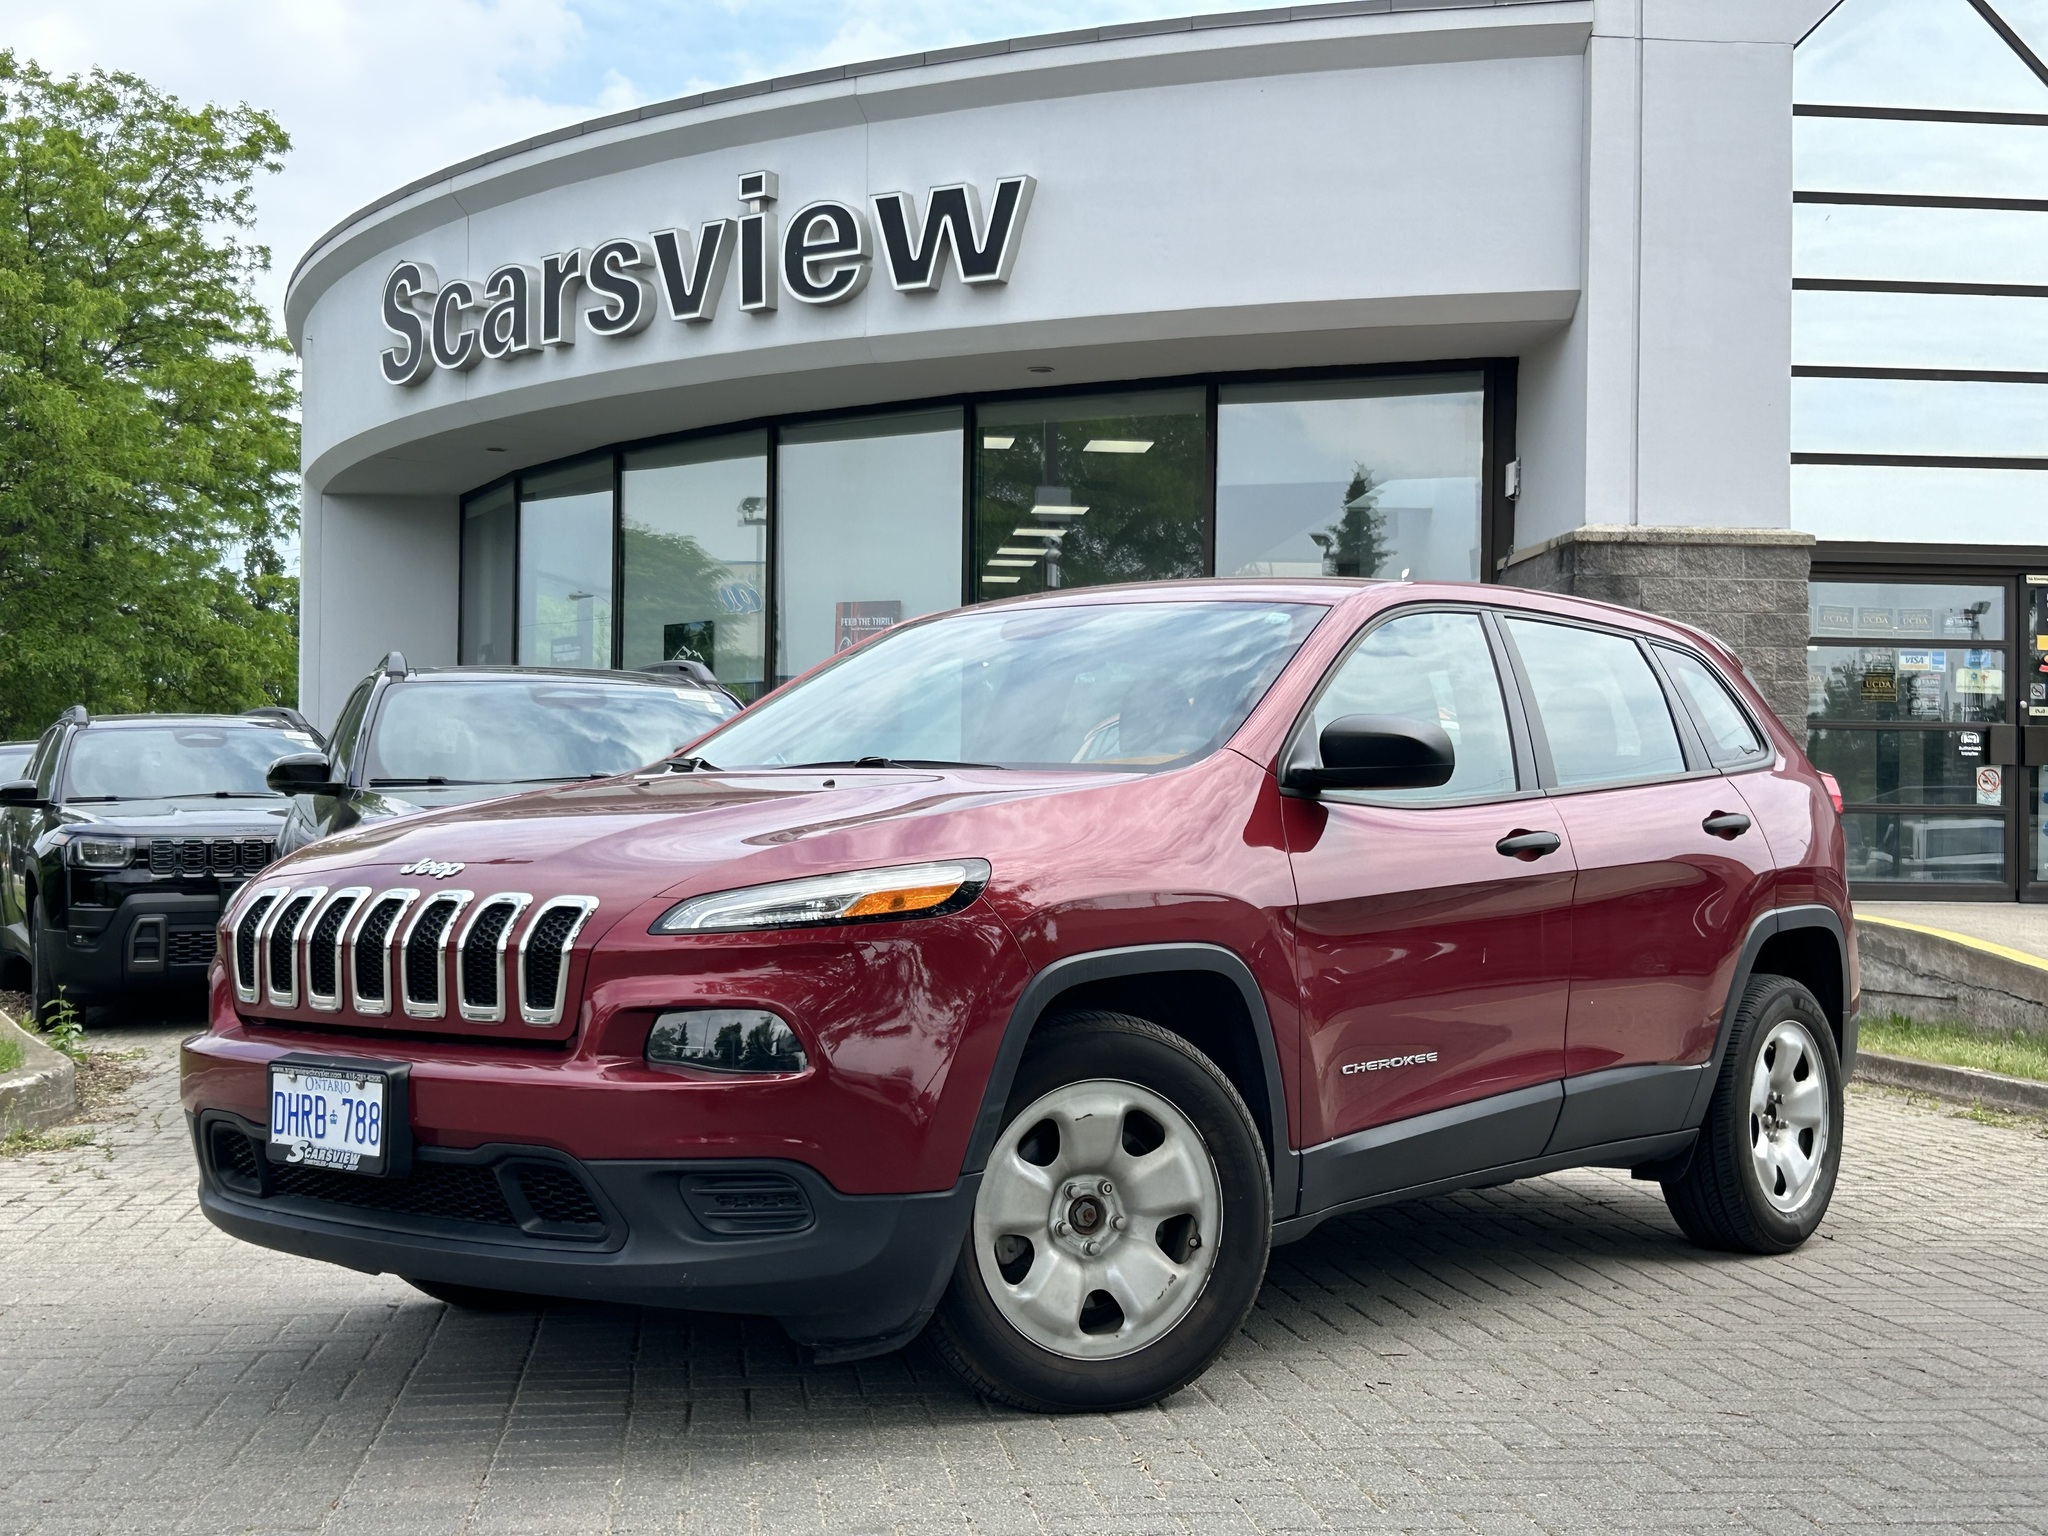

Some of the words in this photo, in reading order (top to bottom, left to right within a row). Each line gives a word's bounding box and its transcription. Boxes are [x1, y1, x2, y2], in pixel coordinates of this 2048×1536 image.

[379, 170, 1036, 386] Scarsview
[858, 617, 871, 626] THE
[872, 616, 894, 626] THRILL
[1823, 614, 1849, 623] UCDA
[1863, 616, 1889, 624] UCDA
[1903, 617, 1928, 625] UCDA
[1905, 656, 1924, 664] VISA
[1865, 681, 1892, 689] UCDA
[400, 857, 466, 880] Jeep
[1341, 1051, 1438, 1075] CHEROKEE
[305, 1075, 351, 1095] ONTARIO
[273, 1090, 327, 1139] DHRB
[341, 1097, 381, 1146] 788
[285, 1139, 361, 1165] SCARSVIEW
